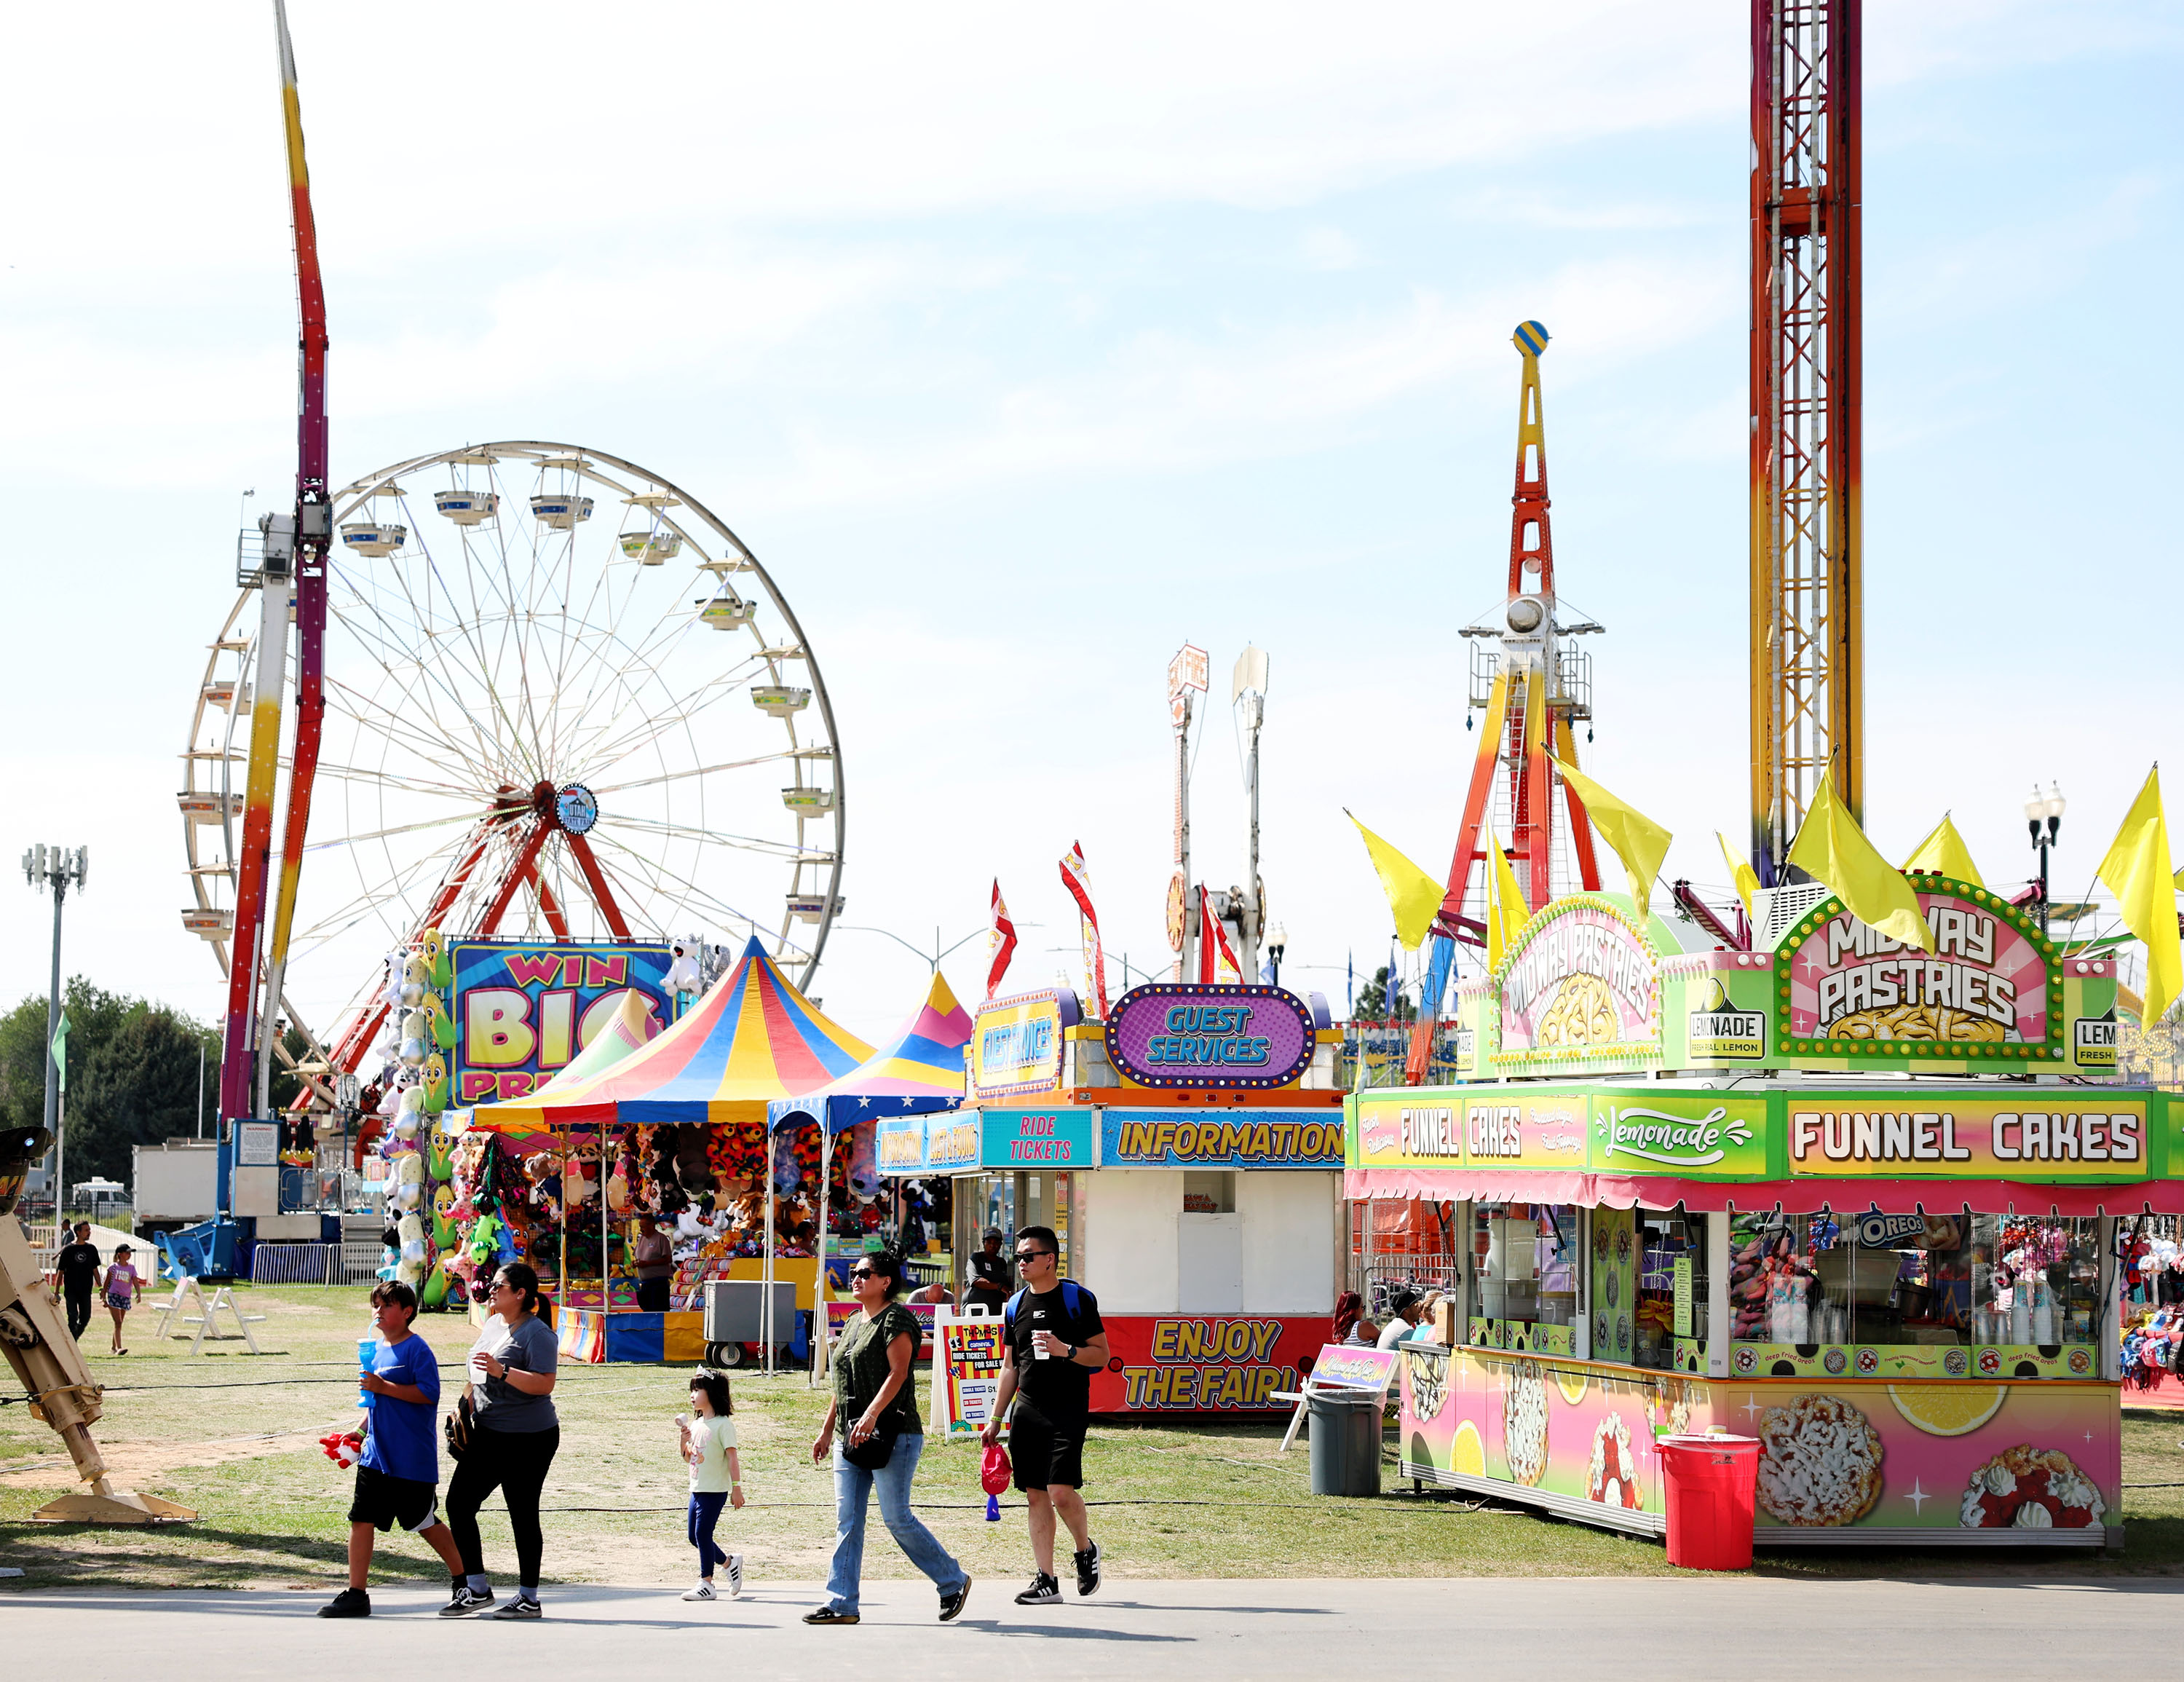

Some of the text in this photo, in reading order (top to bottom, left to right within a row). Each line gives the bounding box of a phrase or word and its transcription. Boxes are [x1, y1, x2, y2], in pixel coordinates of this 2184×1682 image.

[563, 817, 593, 825] STATE FAIR
[569, 803, 586, 817] UTAH
[504, 952, 628, 988] WIN
[1508, 923, 1652, 1030] MIDWAY PASTRIES
[1819, 959, 2017, 1028] PASTRIES
[1166, 1006, 1253, 1035] GUEST
[1693, 1016, 1756, 1036] LEMONADE
[984, 1025, 1011, 1074] GUEST
[1145, 1035, 1272, 1066] SERVICES
[1722, 1043, 1757, 1051] LEMON
[2080, 1051, 2111, 1059] FRESH
[1019, 1116, 1056, 1136] RIDE
[1362, 1111, 1380, 1135] Fresh
[1401, 1105, 1522, 1158] FUNNEL CAKES
[1606, 1105, 1727, 1166] Lemonade
[1793, 1112, 2139, 1162] FUNNEL CAKES
[881, 1130, 922, 1168] INFORMATION
[930, 1123, 976, 1166] LOST & FOUND
[1010, 1139, 1072, 1161] TICKETS
[1117, 1121, 1345, 1162] INFORMATION
[1367, 1134, 1394, 1155] Delicious
[965, 1351, 987, 1359] TICKETS
[1151, 1320, 1282, 1363] ENJOY
[986, 1360, 998, 1368] SALE
[1765, 1352, 1781, 1362] deep
[1781, 1351, 1797, 1360] fried
[2008, 1353, 2023, 1362] deep
[2024, 1352, 2040, 1361] fried
[1122, 1366, 1297, 1408] THE FAIR!
